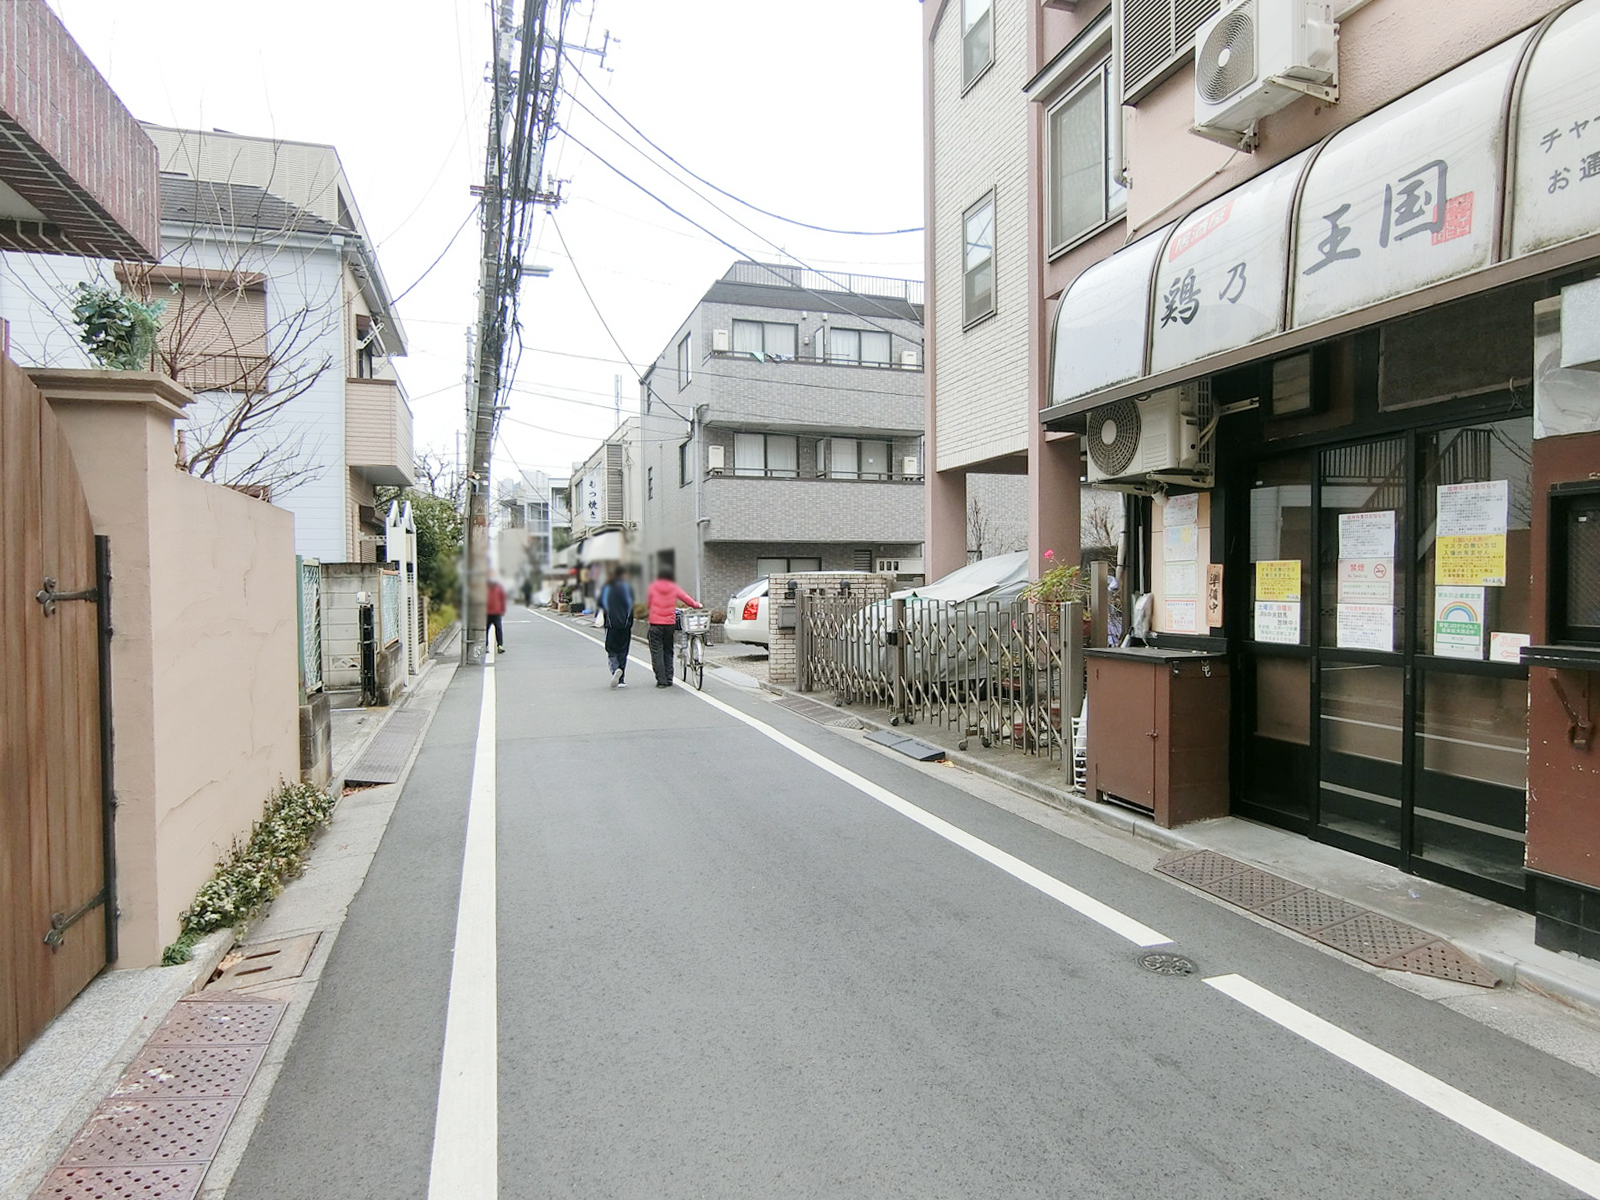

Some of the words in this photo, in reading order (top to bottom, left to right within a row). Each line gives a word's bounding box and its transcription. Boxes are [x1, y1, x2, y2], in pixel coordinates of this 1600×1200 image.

[1174, 204, 1229, 254] 居酒屋
[588, 480, 598, 519] もつ焼き
[1350, 563, 1365, 572] 禁煙
[1208, 573, 1220, 614] 準備中
[1276, 604, 1293, 612] 日曜日
[1499, 636, 1521, 647] 入口
